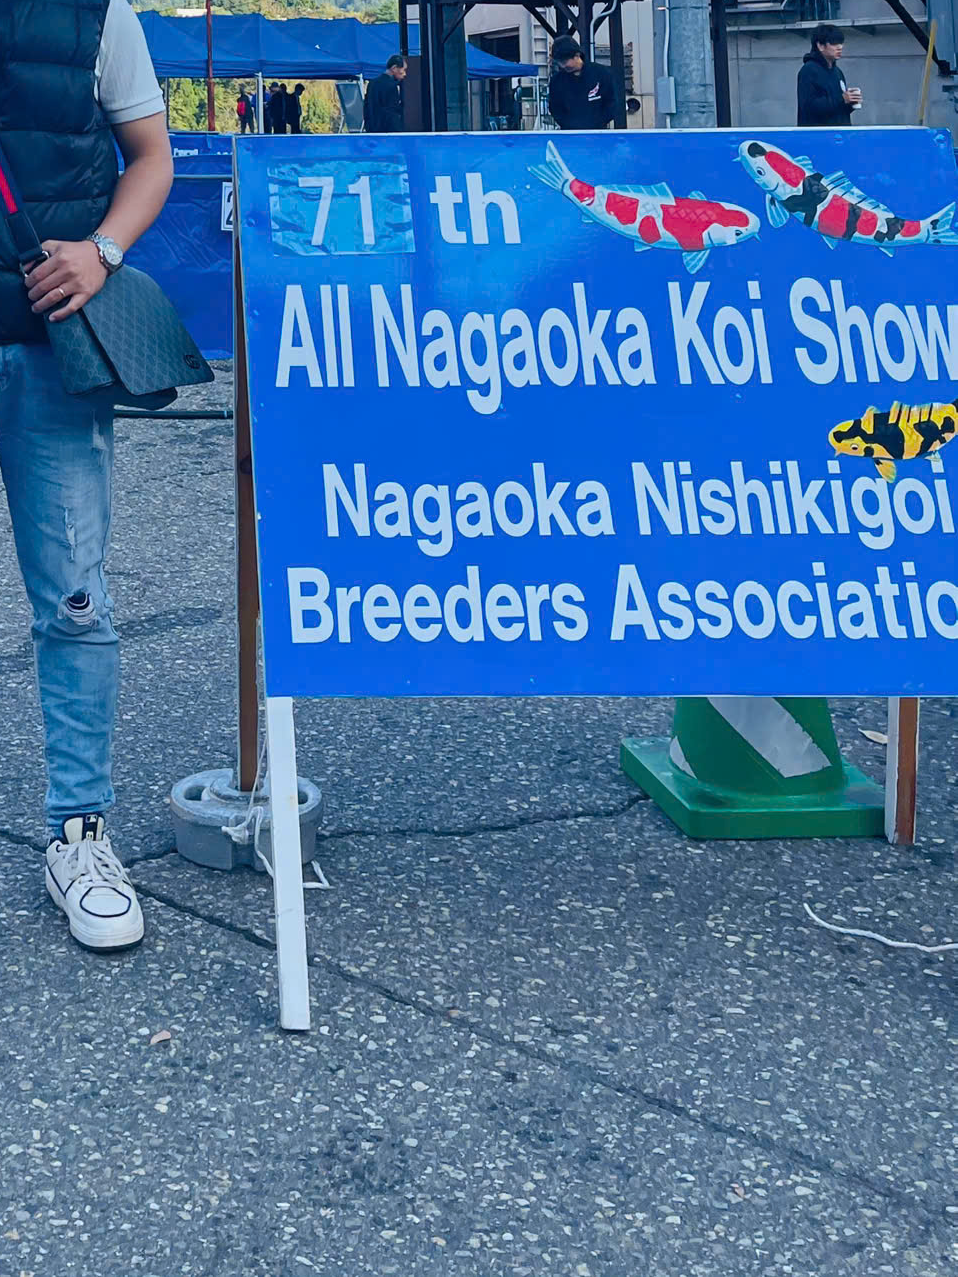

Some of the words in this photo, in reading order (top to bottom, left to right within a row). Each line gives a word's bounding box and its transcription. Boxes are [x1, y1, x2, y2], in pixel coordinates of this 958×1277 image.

[298, 176, 376, 246] 71
[429, 172, 522, 245] th
[275, 284, 355, 388] All
[370, 282, 657, 415] Nagaoka
[668, 280, 773, 385] Koi
[789, 277, 958, 385] Show
[322, 462, 616, 557] Nagaoka
[631, 459, 955, 550] Nishikigoi
[287, 565, 589, 644] Breeders
